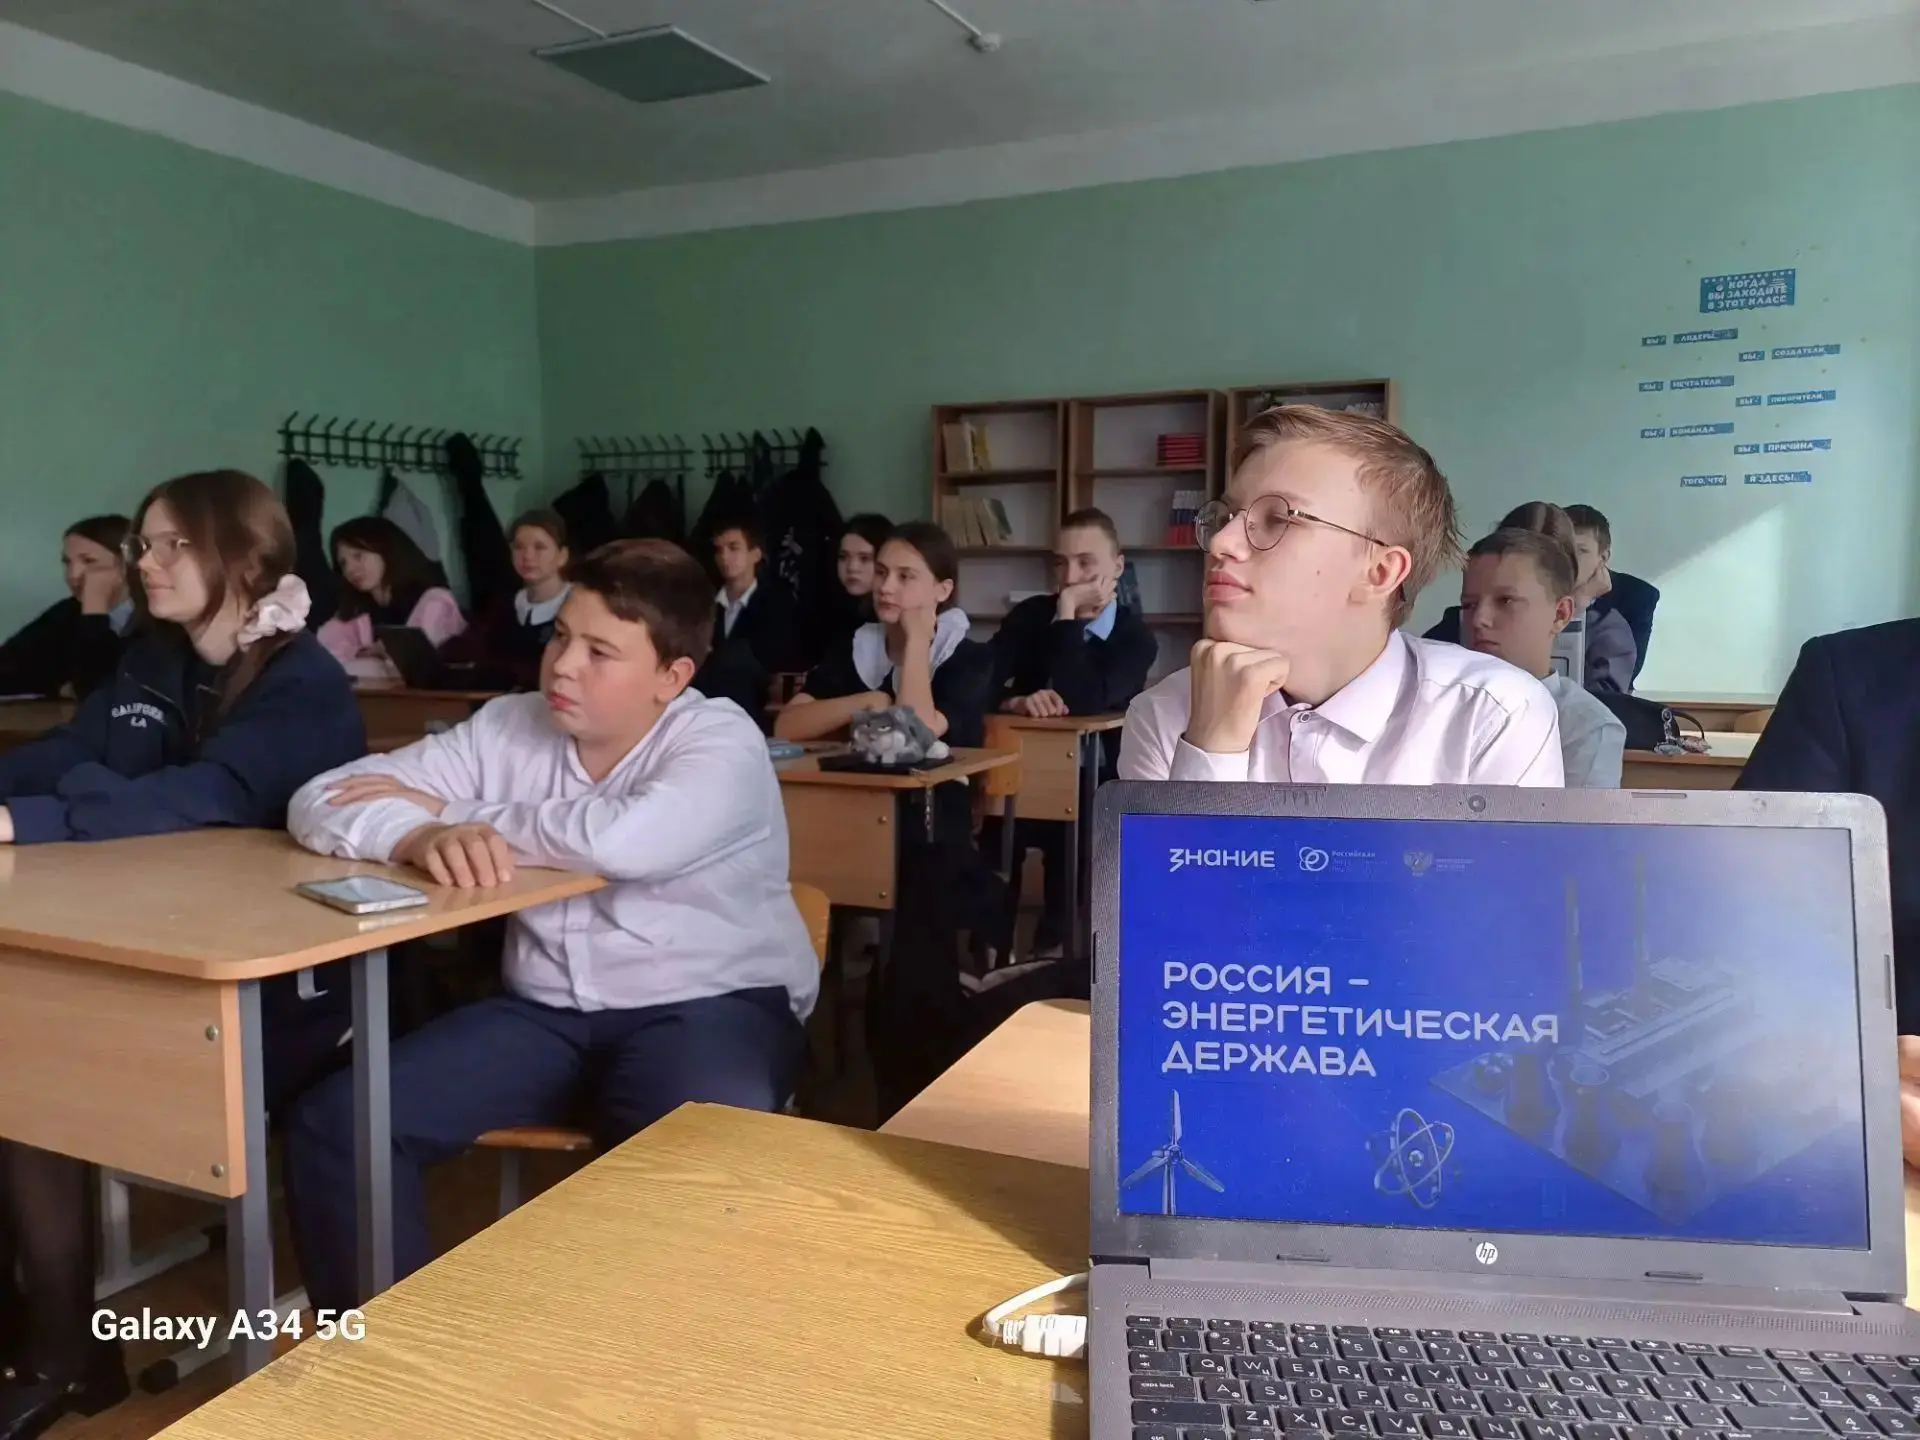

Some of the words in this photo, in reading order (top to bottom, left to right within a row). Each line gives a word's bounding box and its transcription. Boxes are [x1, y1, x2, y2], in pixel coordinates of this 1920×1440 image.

[1708, 291, 1725, 301] ВЫ
[1726, 284, 1788, 299] ЗАХОДИТЕ
[1728, 278, 1767, 289] КОГДА
[1707, 301, 1715, 310] В
[1717, 298, 1746, 309] ЭТОТ
[1748, 295, 1788, 308] КЛАСС
[1767, 442, 1814, 452] ПРИЧИНА
[1707, 476, 1724, 484] ЧТО
[1163, 961, 1331, 995] РОССИЯ
[1162, 1000, 1559, 1044] ЭНЕРГЕТИЧЕСКАЯ
[1161, 1040, 1377, 1077] ДЕРЖАВА
[1478, 1241, 1497, 1264] hp
[1222, 1337, 1231, 1345] 2
[1266, 1339, 1275, 1347] 3
[1309, 1341, 1319, 1349] 4
[1354, 1343, 1363, 1352] 5
[1398, 1345, 1408, 1354] 6
[1441, 1347, 1451, 1355] 7
[1487, 1349, 1499, 1357] 8
[1533, 1351, 1544, 1359] 9
[1201, 1359, 1215, 1368] Q
[1243, 1360, 1261, 1370] W
[1292, 1363, 1304, 1372] E
[1337, 1365, 1351, 1375] R
[1383, 1367, 1395, 1377] T
[1428, 1369, 1440, 1378] Y
[1474, 1371, 1489, 1381] U
[1616, 1379, 1629, 1389] P
[1217, 1383, 1231, 1393] A
[1264, 1386, 1276, 1395] S
[1309, 1388, 1323, 1398] D
[1357, 1390, 1368, 1400] F
[1404, 1393, 1418, 1403] G
[1451, 1395, 1466, 1405] H
[1504, 1398, 1513, 1408] J
[1546, 1399, 1563, 1410] K
[1596, 1401, 1612, 1413] L
[1246, 1410, 1258, 1420] Z
[1293, 1412, 1308, 1423] X
[1341, 1415, 1356, 1426] C
[1388, 1417, 1403, 1428] V
[1439, 1420, 1454, 1430] B
[1488, 1422, 1505, 1433] N
[1537, 1424, 1555, 1436] M
